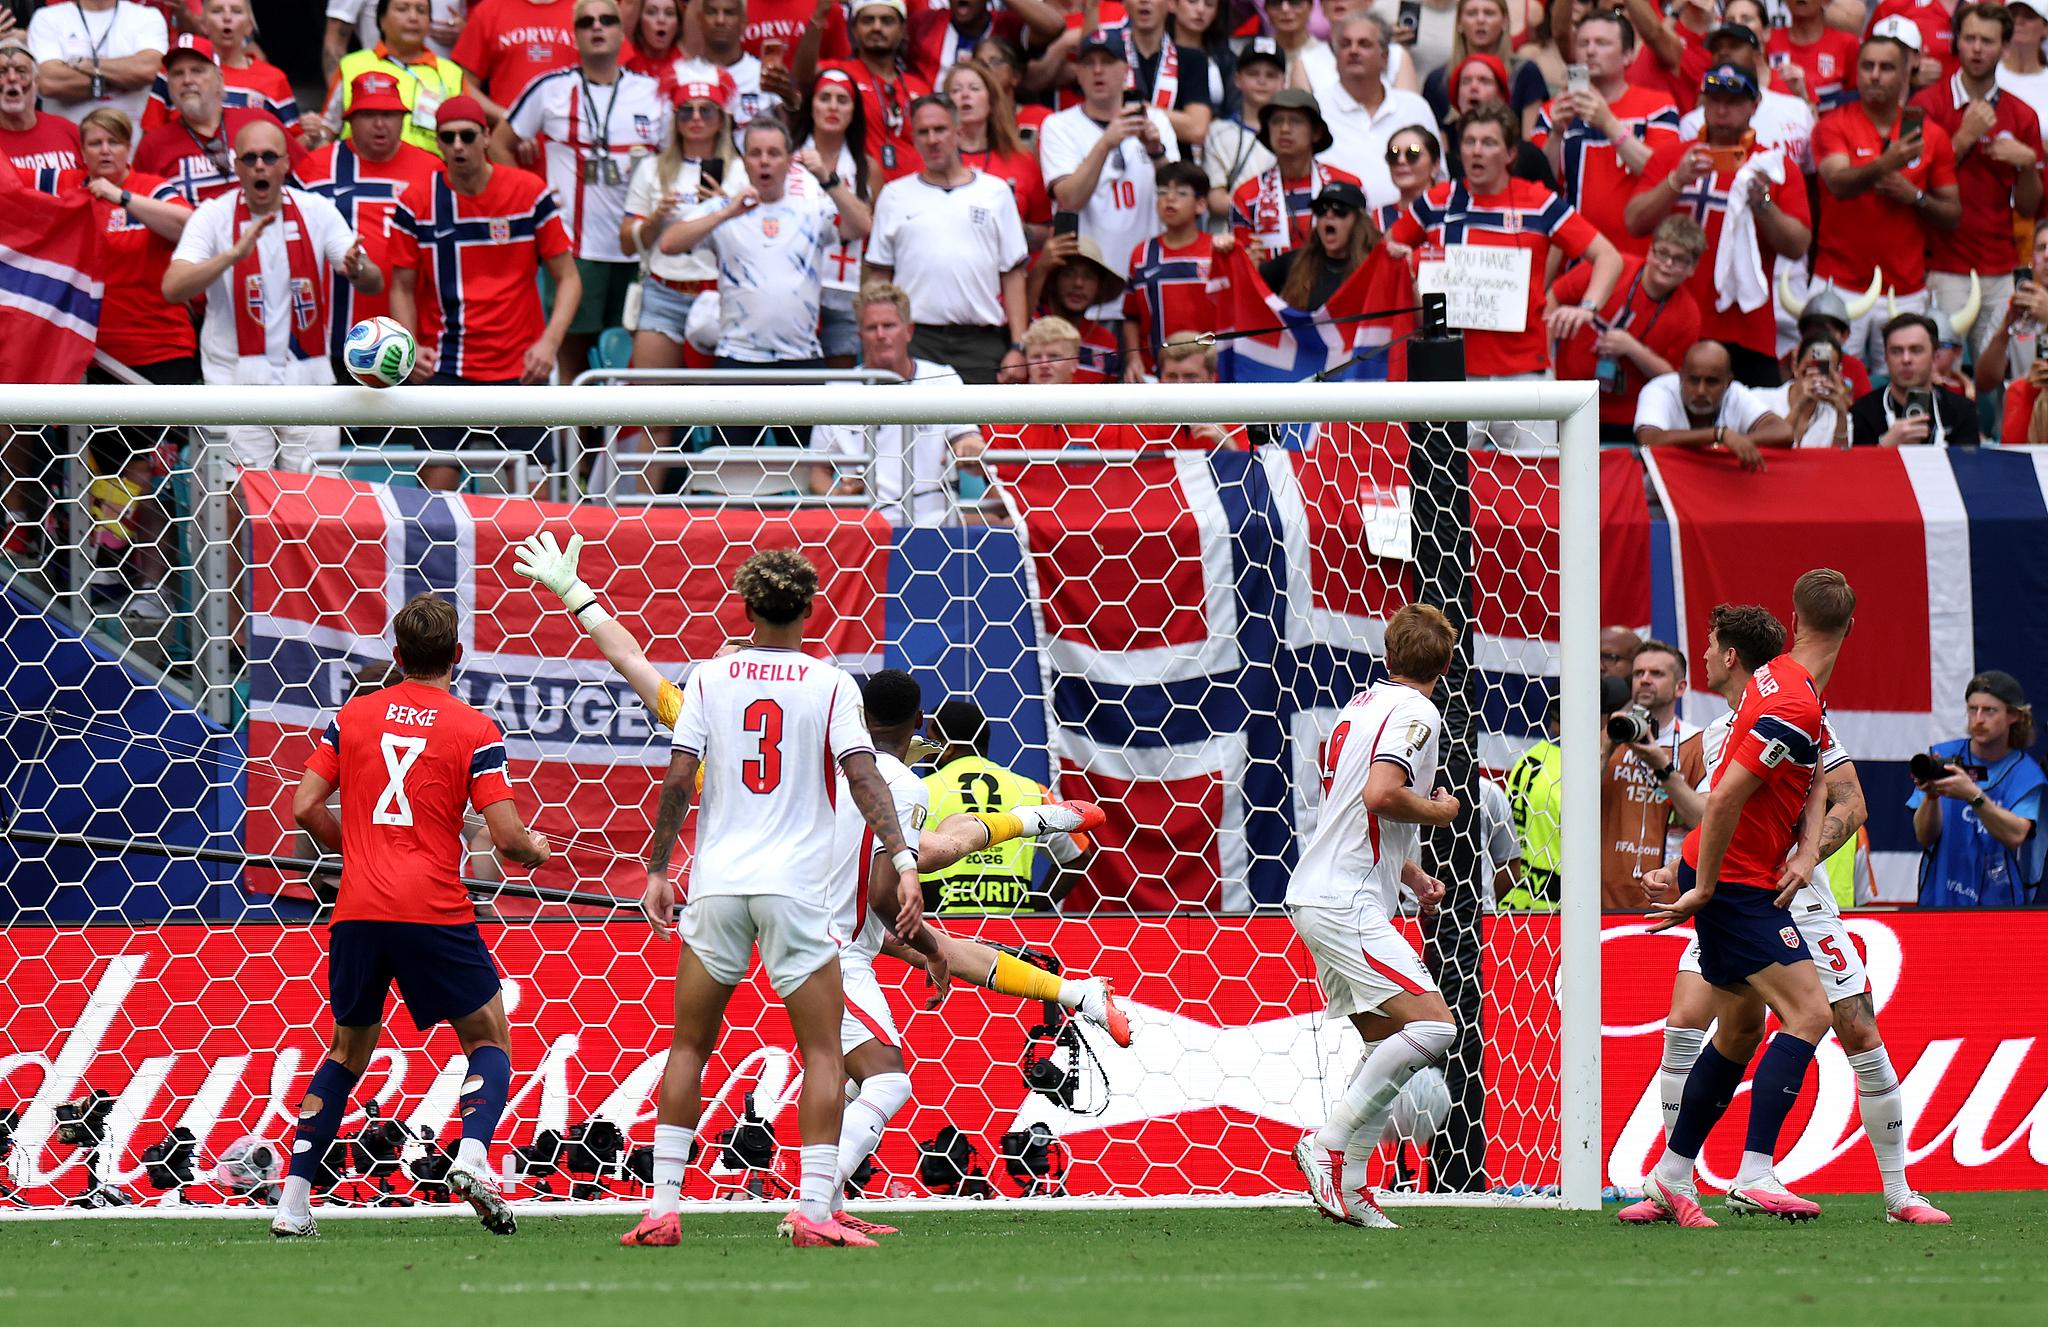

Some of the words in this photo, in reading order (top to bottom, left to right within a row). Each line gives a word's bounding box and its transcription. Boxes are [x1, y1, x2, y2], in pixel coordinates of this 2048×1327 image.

[740, 19, 806, 43] ORWA
[1112, 179, 1136, 210] 10
[729, 661, 810, 682] O'REILLY
[385, 703, 439, 727] BERGE
[742, 698, 784, 795] 3
[372, 731, 428, 827] 8
[966, 854, 1004, 865] 2026
[1817, 934, 1848, 972] 5
[1661, 1101, 1680, 1112] ENG
